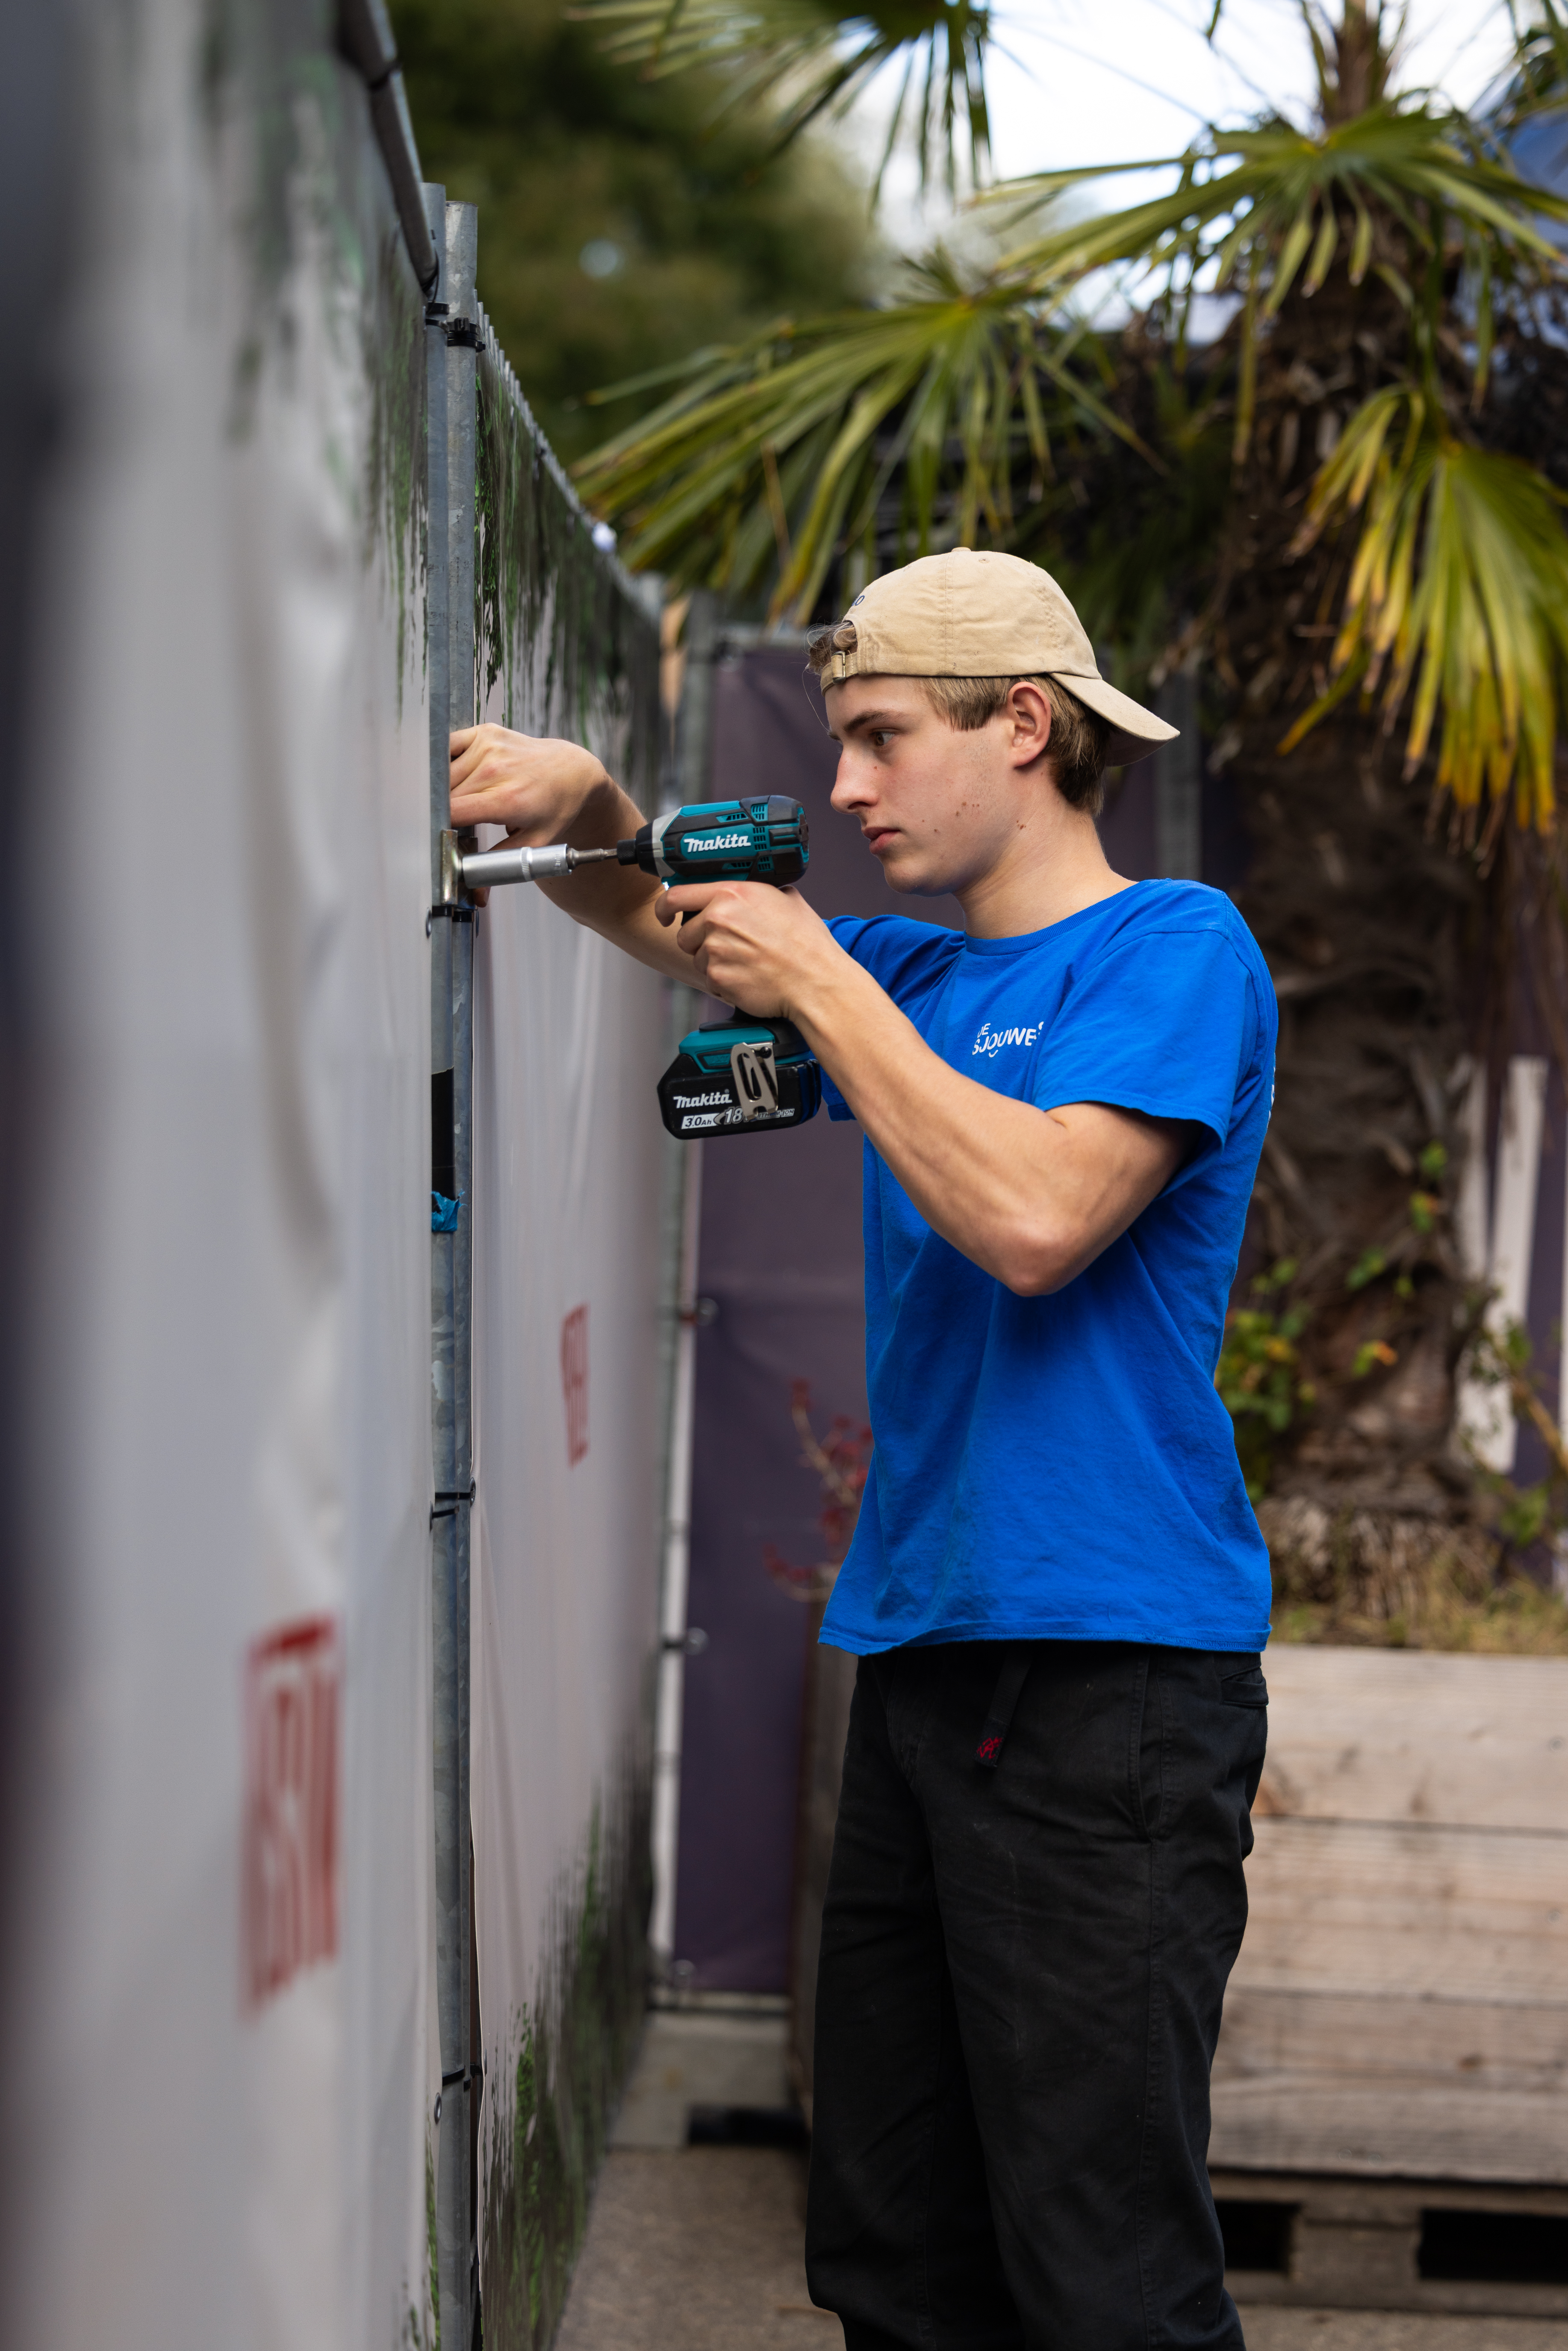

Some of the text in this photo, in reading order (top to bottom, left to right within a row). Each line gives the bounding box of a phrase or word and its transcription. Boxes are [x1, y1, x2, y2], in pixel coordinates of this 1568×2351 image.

[972, 1021, 1044, 1055] SJOUWE
[685, 1115, 712, 1127] 3.0Ah
[725, 1107, 749, 1124] 18
